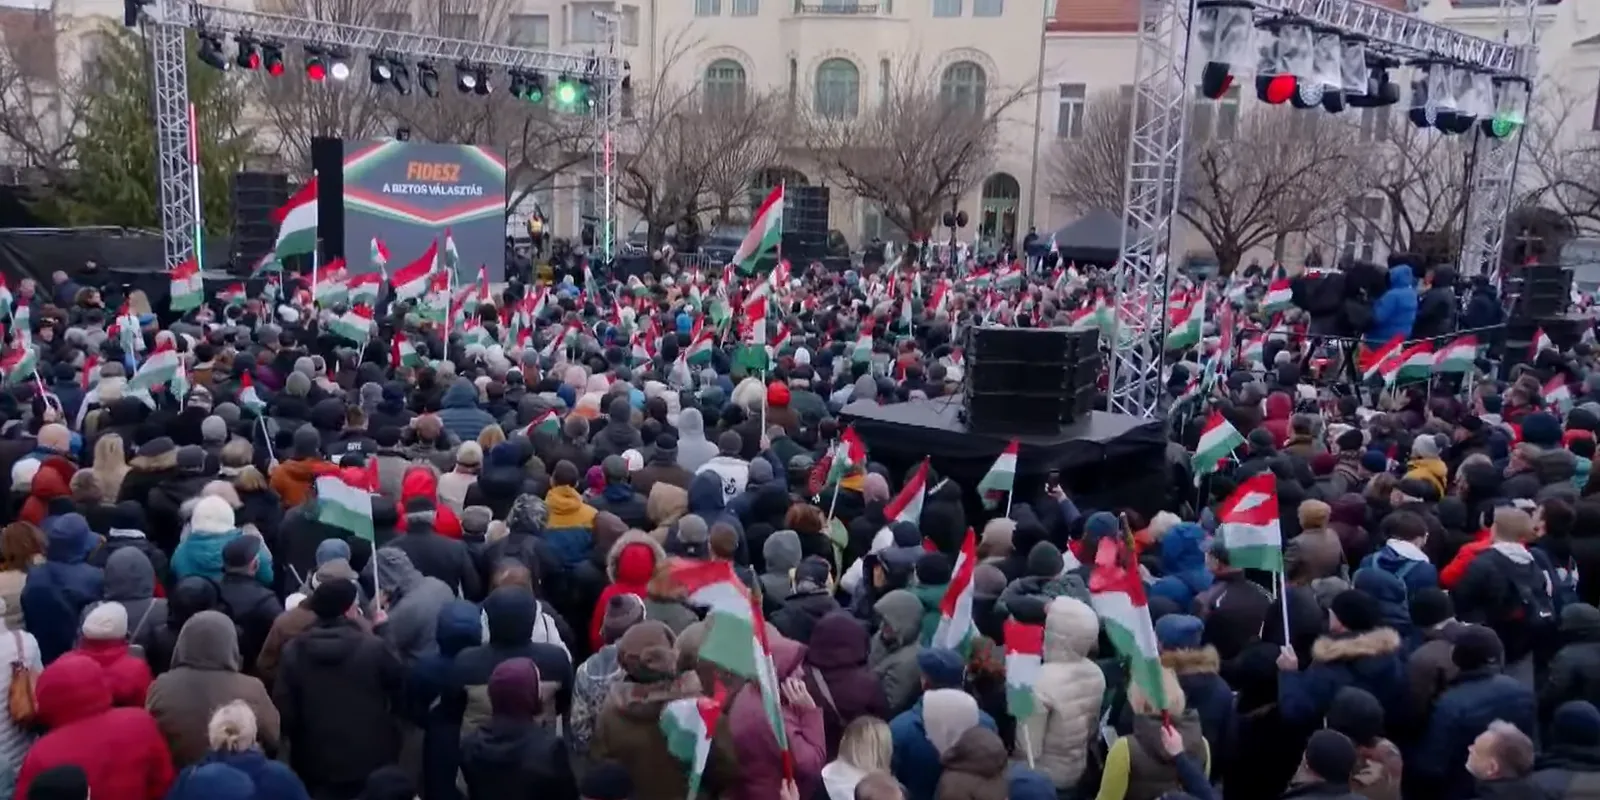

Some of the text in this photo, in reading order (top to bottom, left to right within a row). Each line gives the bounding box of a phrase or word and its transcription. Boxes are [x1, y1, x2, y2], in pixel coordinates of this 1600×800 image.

[407, 161, 461, 181] FIDESZ
[383, 183, 483, 196] A BIZTOS VÁLASZTÁS
